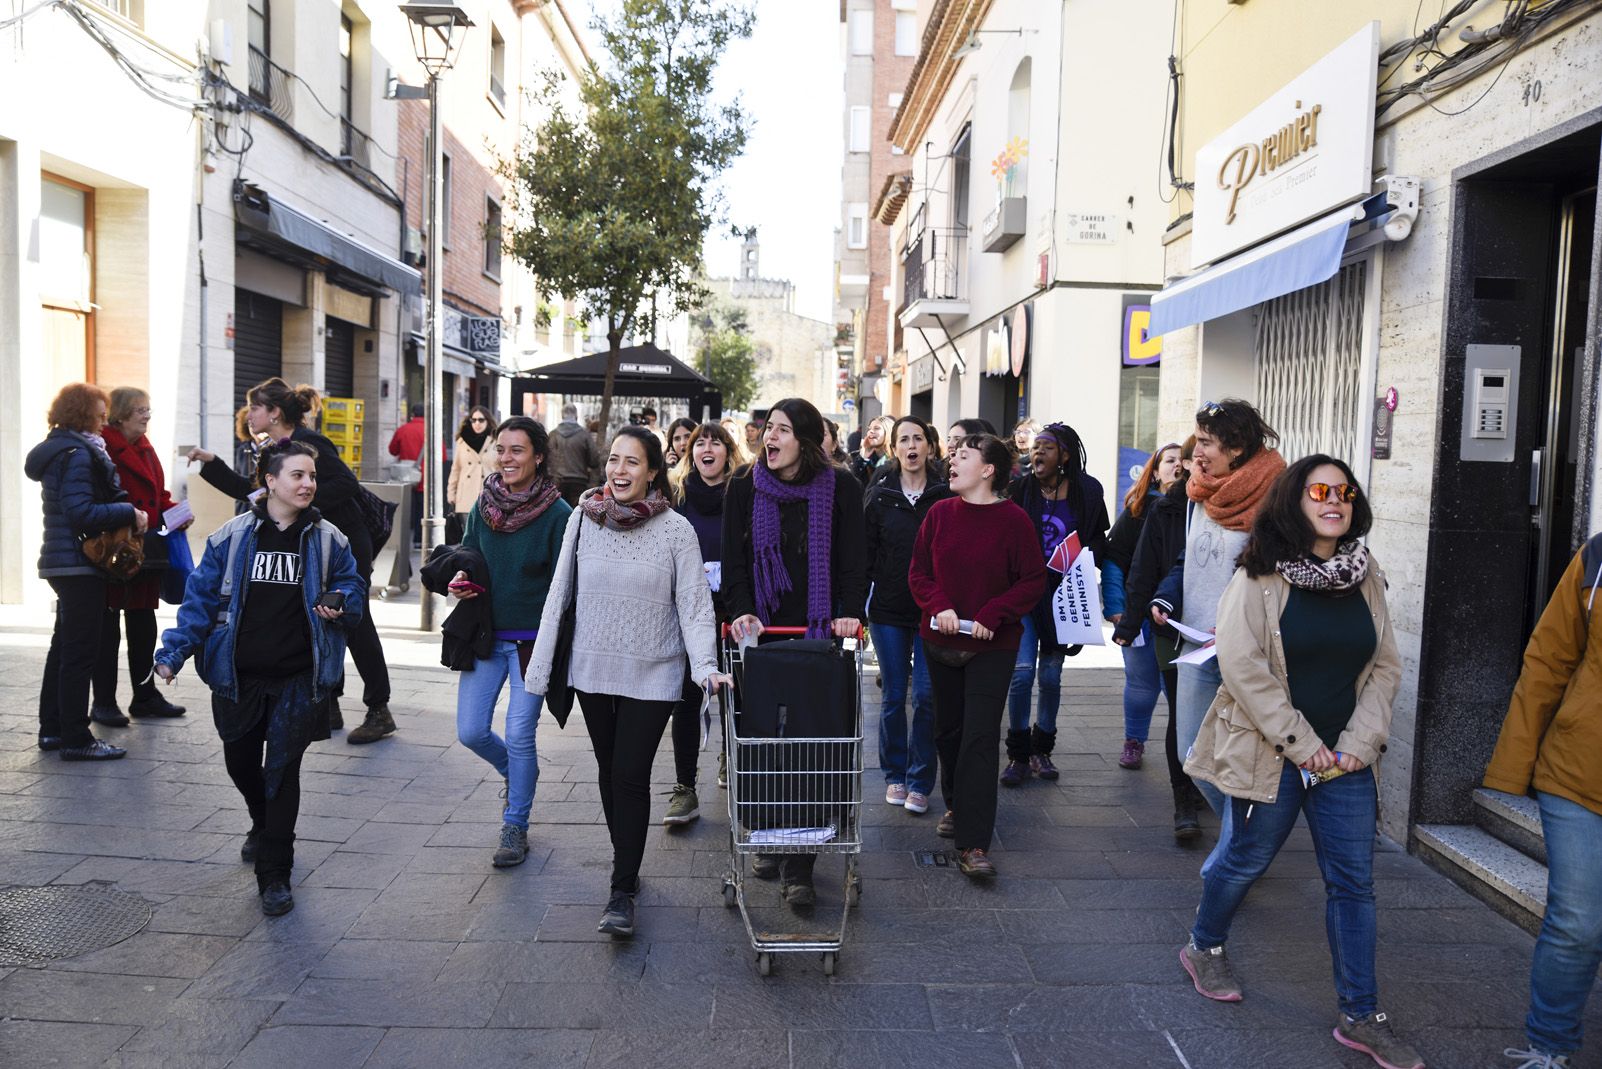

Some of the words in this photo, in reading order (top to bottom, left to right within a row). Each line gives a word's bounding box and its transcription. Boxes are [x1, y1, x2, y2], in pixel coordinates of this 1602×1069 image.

[1522, 80, 1542, 107] 40
[1217, 100, 1322, 225] Premier
[1059, 606, 1067, 622] 8M
[1066, 569, 1079, 623] GENERAL
[1075, 563, 1092, 628] FEMINISTA
